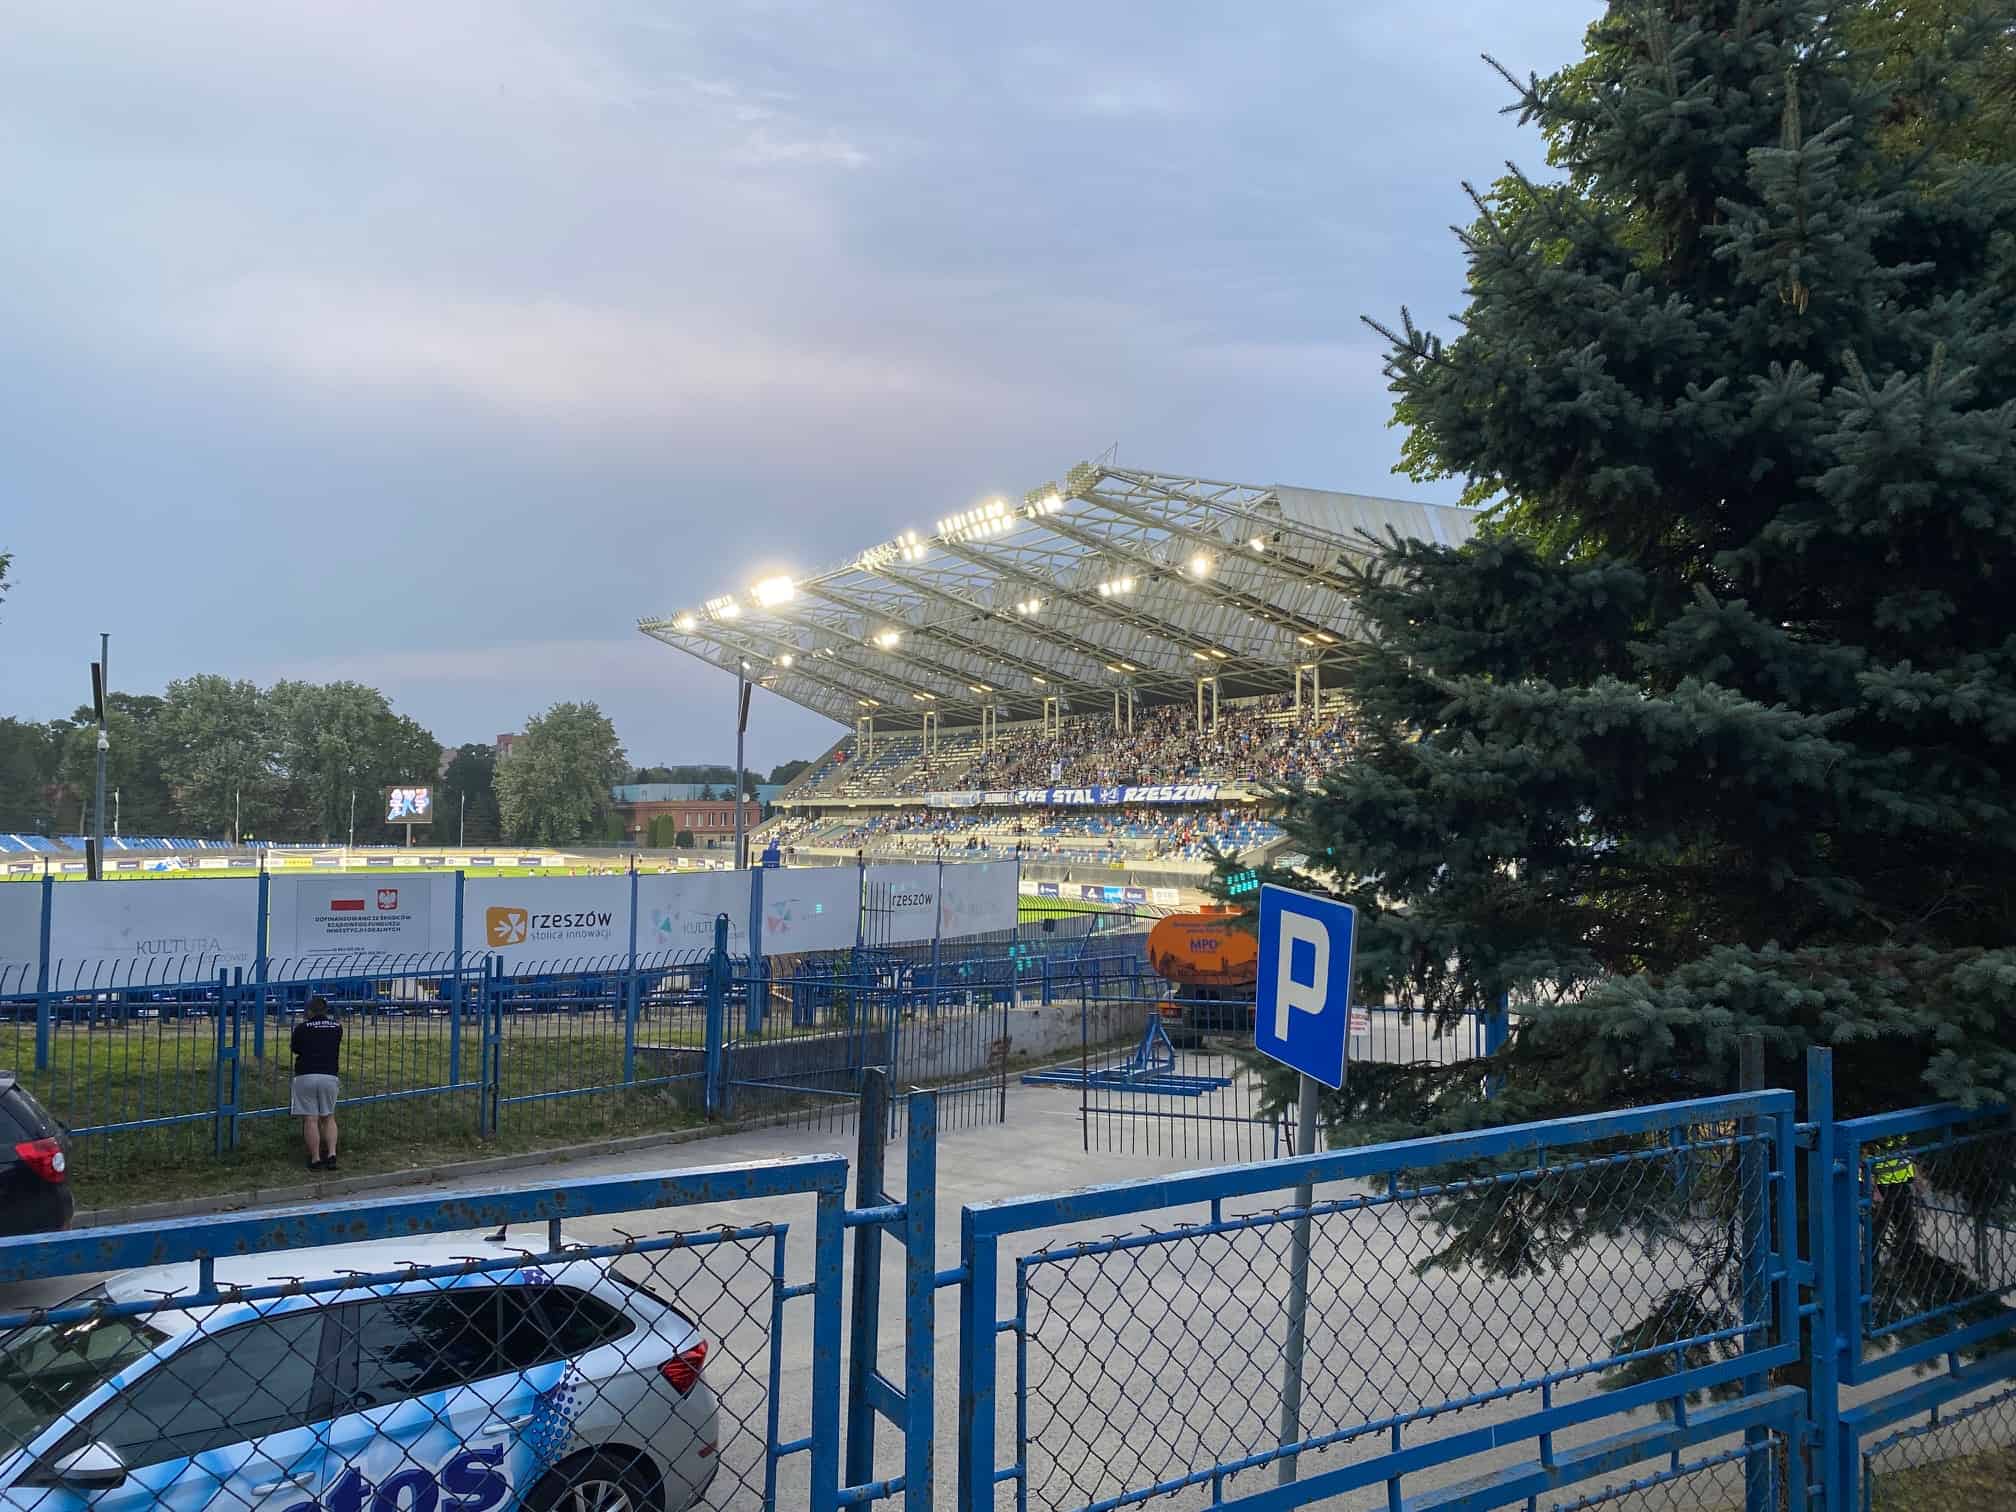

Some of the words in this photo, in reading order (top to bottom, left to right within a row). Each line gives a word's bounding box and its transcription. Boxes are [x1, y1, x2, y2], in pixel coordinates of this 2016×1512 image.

[1053, 789, 1095, 804] STAL
[1124, 784, 1218, 801] RZESZÓW
[892, 893, 933, 907] rzeszów
[531, 910, 612, 929] rzeszów
[136, 938, 221, 955] KULTURA
[1274, 909, 1330, 1042] P
[282, 1442, 507, 1512] tos
